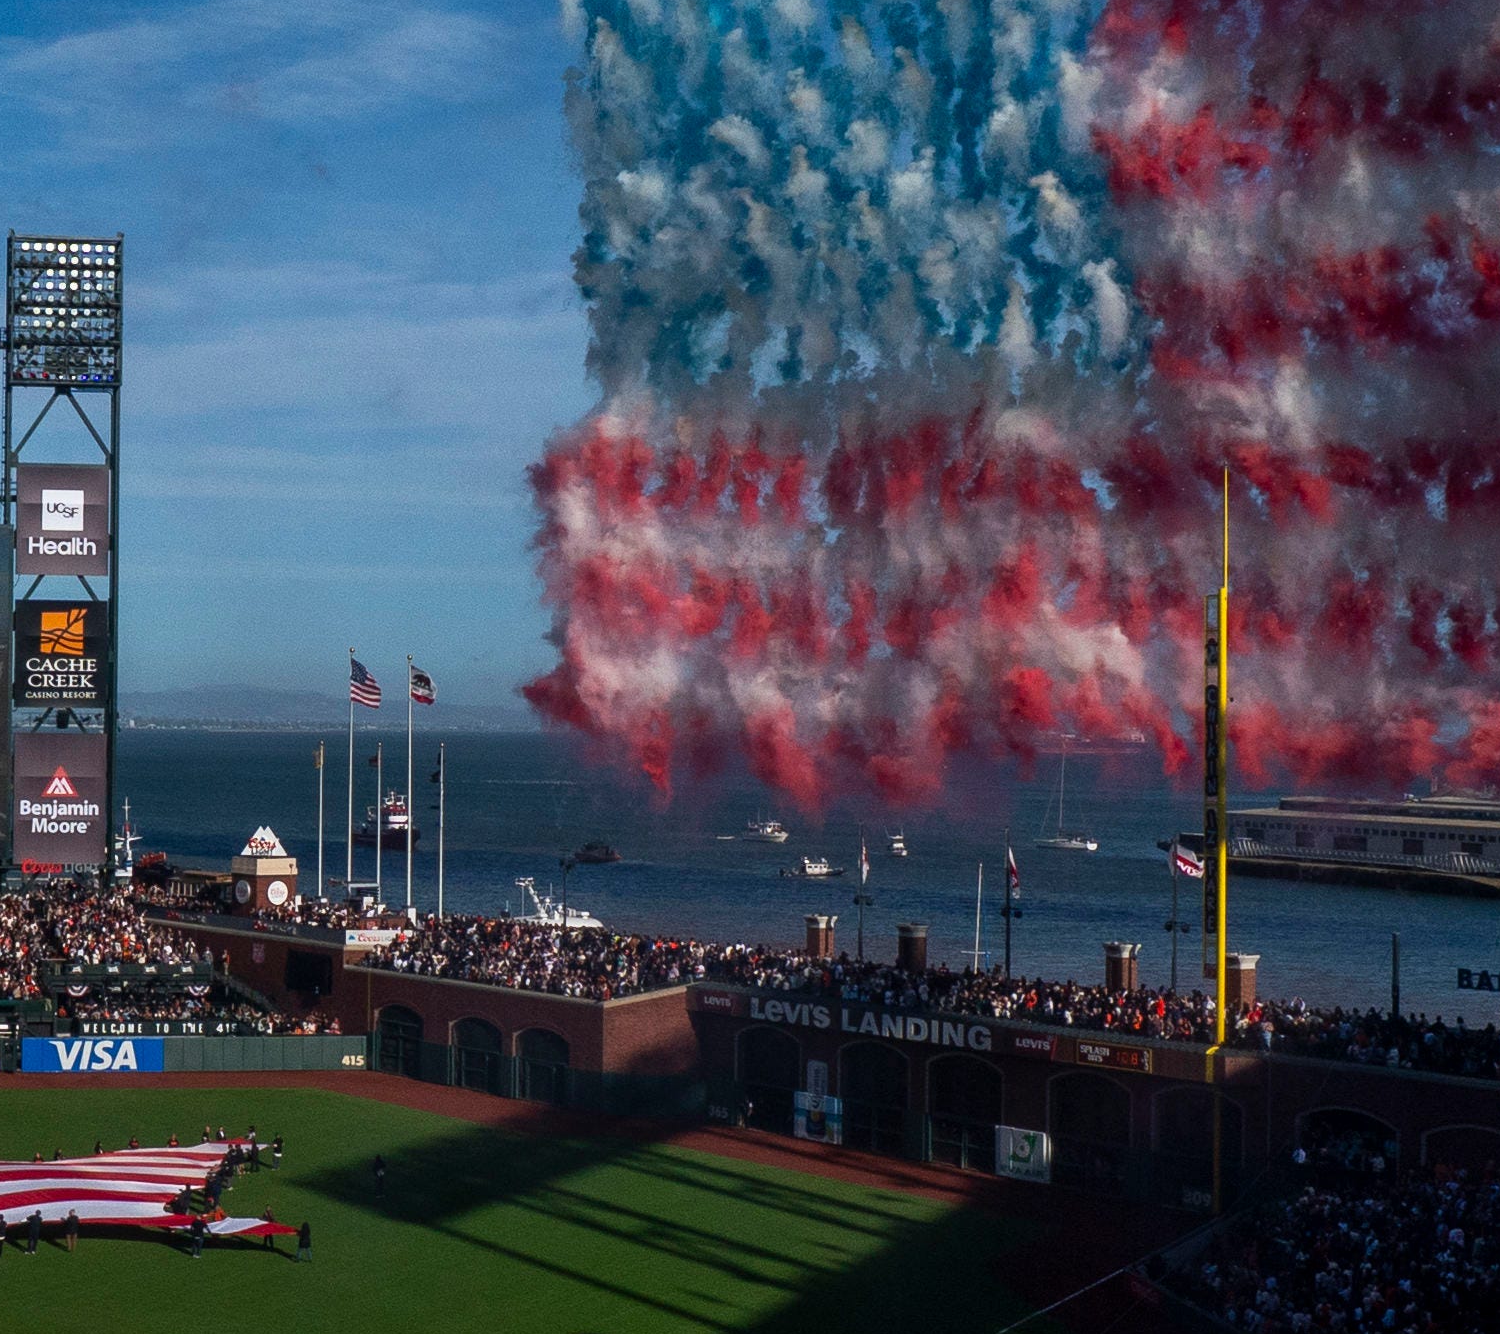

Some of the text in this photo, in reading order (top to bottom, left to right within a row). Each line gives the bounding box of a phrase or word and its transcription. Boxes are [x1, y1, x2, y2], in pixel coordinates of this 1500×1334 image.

[46, 502, 79, 519] UCSF
[28, 537, 97, 556] Health
[26, 658, 97, 672] CACHE
[27, 674, 94, 688] CREEK
[20, 799, 99, 820] Benjamin
[31, 818, 88, 833] Moore
[21, 859, 63, 874] Coors
[83, 1023, 143, 1034] WELCOME
[156, 1023, 170, 1033] TO
[182, 1023, 204, 1034] THE
[841, 1008, 992, 1051] LANDING
[48, 1039, 137, 1071] VISA
[341, 1055, 365, 1067] 415
[708, 1105, 730, 1120] 365
